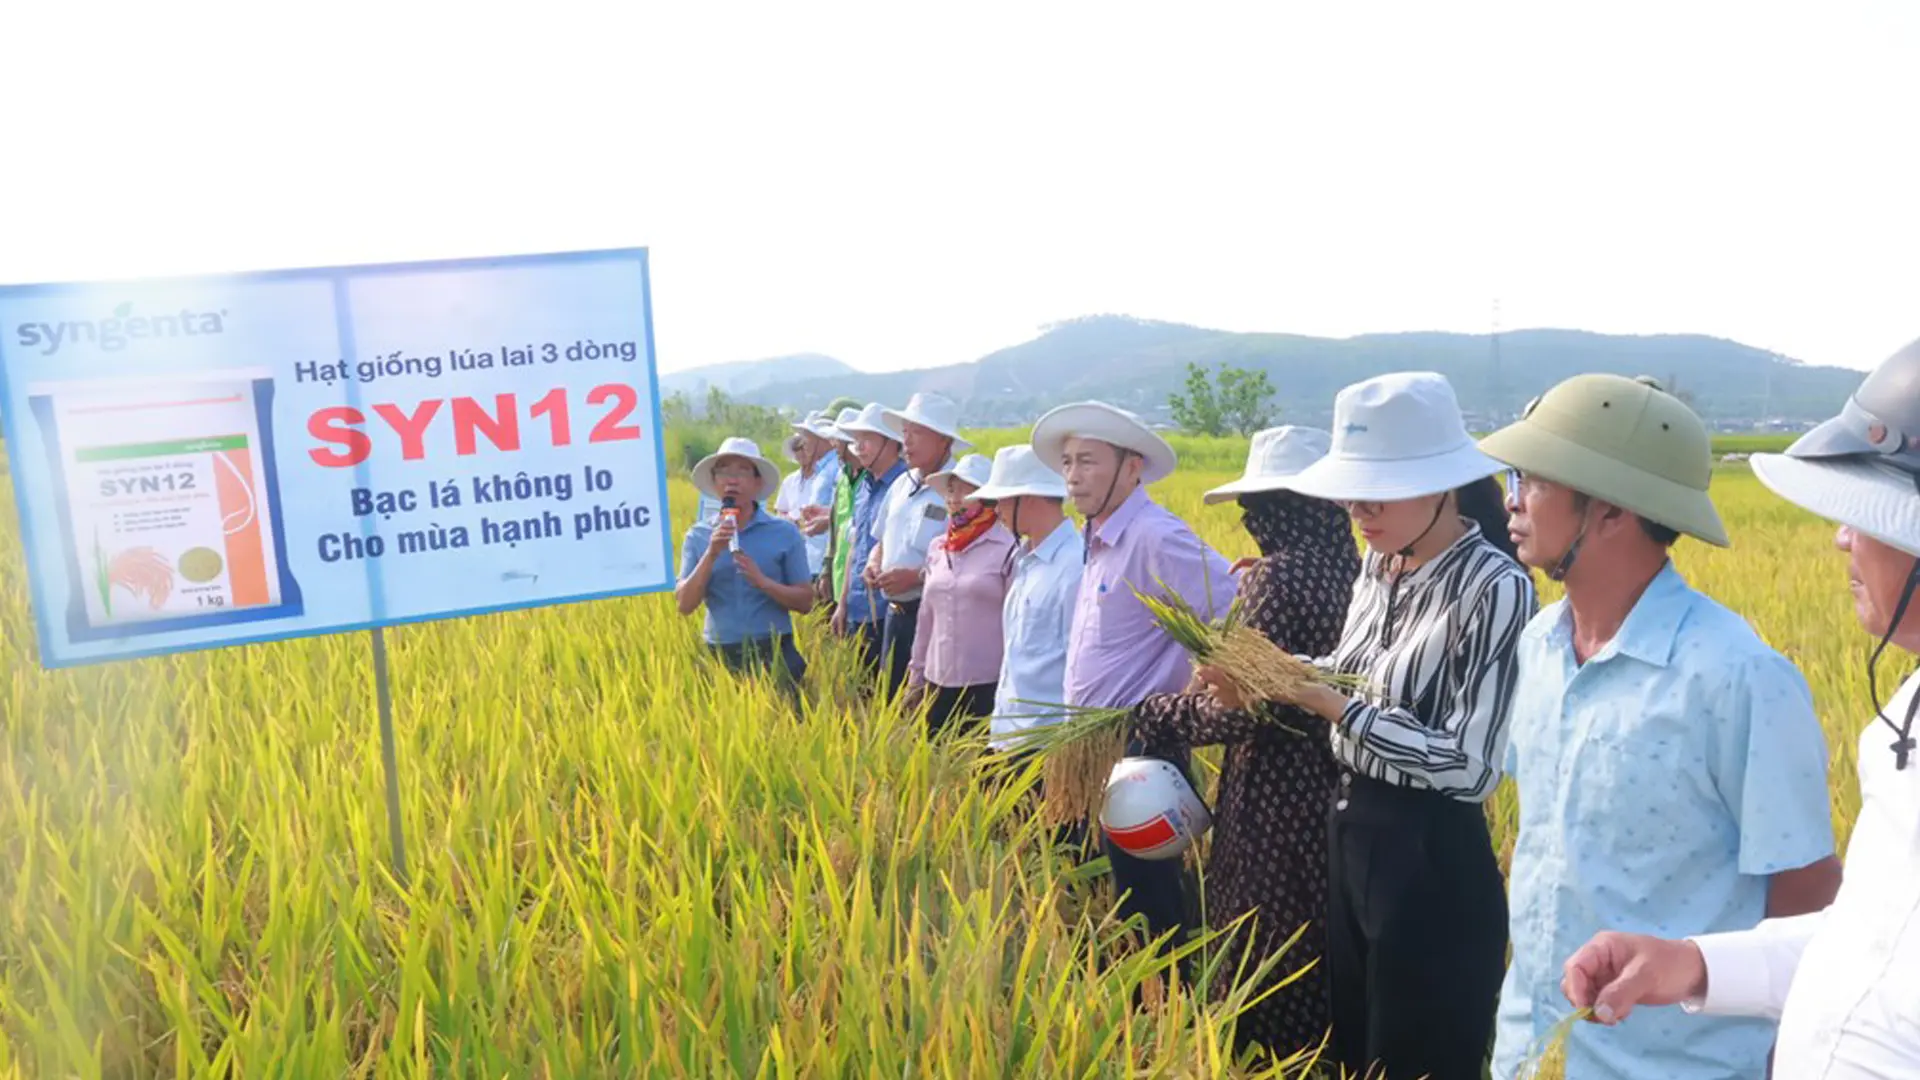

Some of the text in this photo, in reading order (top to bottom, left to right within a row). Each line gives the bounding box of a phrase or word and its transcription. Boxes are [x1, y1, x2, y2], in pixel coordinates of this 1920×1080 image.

[17, 307, 224, 356] syngenta
[294, 340, 637, 386] Hạt giống lúa lai 3 dòng
[307, 383, 641, 468] SYN12
[100, 472, 196, 497] SYN12
[351, 465, 613, 520] Bạc lá không lo
[317, 501, 650, 563] Cho mùa hạnh phúc
[197, 594, 224, 607] 1 kg
